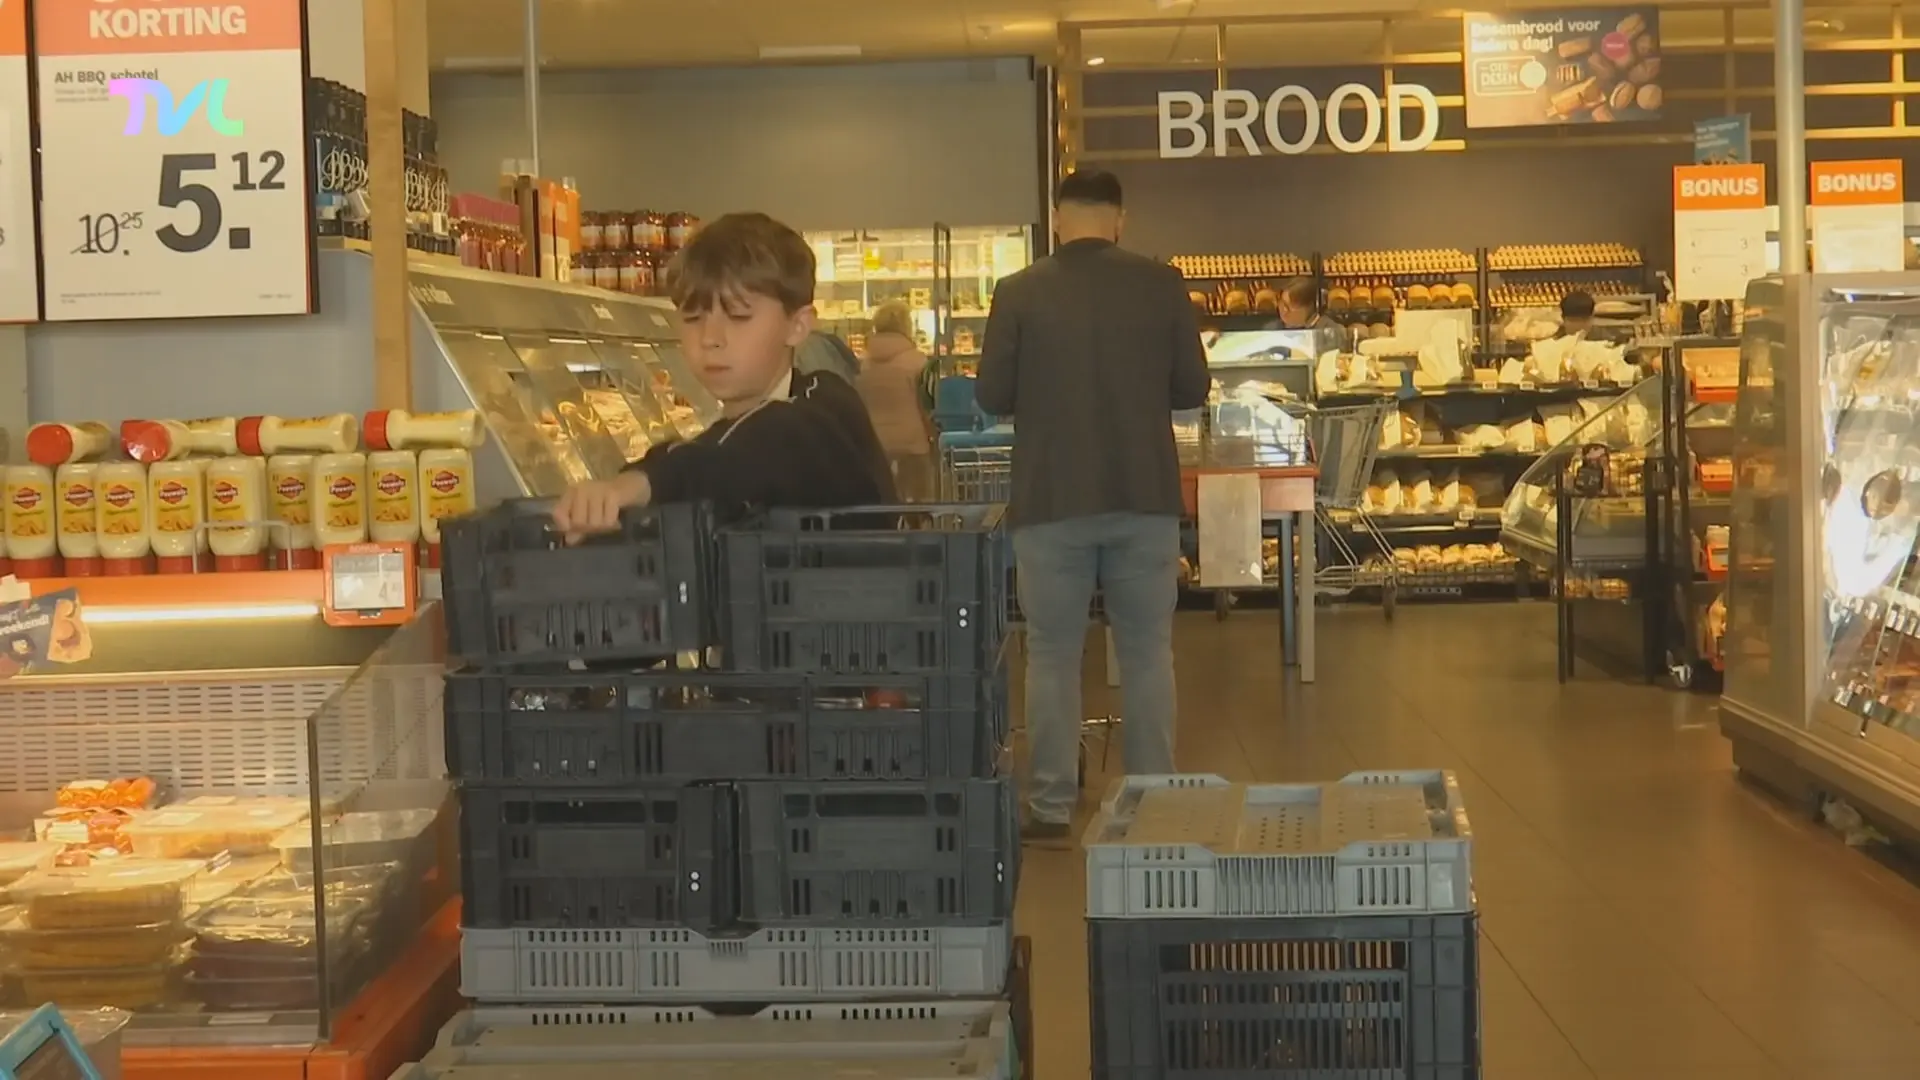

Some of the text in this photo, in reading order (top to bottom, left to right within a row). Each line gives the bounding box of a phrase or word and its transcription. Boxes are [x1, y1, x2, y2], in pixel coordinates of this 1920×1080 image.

[89, 6, 247, 39] KORTING
[1567, 19, 1601, 33] voor
[1521, 35, 1554, 53] dag!
[54, 71, 74, 84] AH
[77, 70, 106, 86] BBQ
[1157, 83, 1440, 159] BROOD
[1680, 177, 1760, 198] BONUS
[1817, 171, 1897, 194] BONUS
